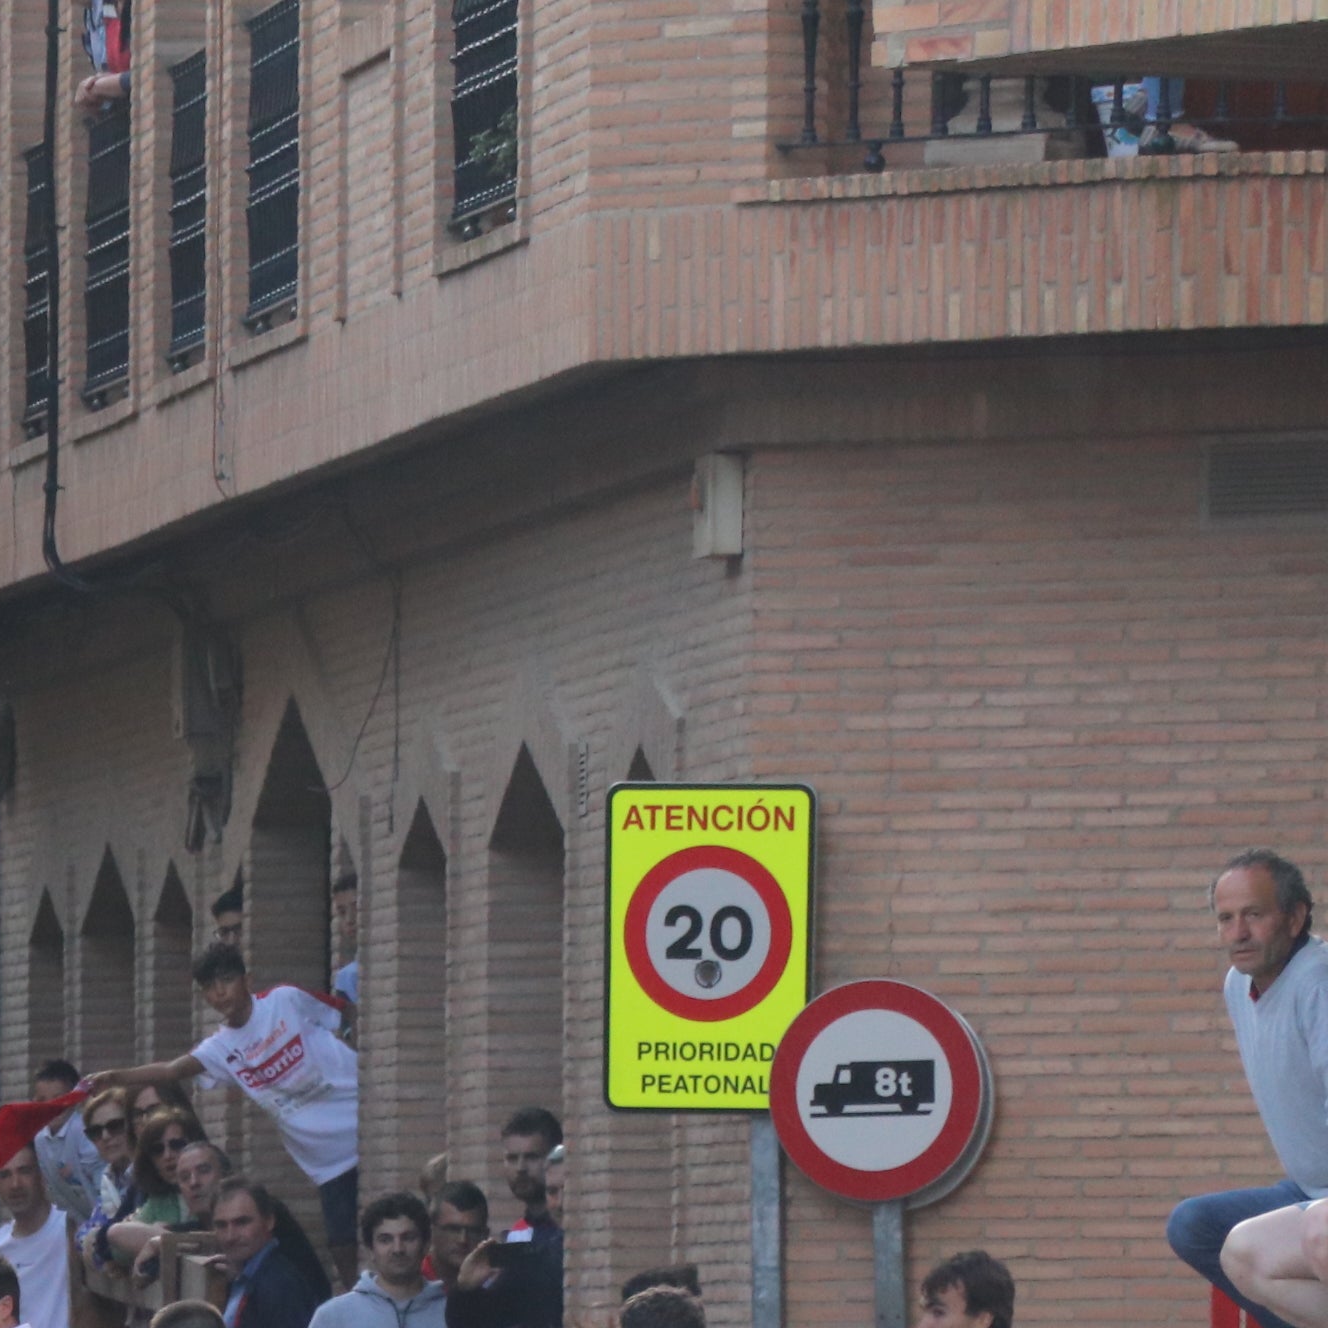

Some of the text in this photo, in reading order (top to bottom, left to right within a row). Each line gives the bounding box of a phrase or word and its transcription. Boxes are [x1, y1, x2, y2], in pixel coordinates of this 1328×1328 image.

[622, 799, 795, 831] ATENCIÓN
[664, 904, 753, 961] 20
[637, 1041, 775, 1062] PRIORIDAD
[641, 1073, 770, 1095] PEATONAL
[875, 1066, 913, 1097] 8t
